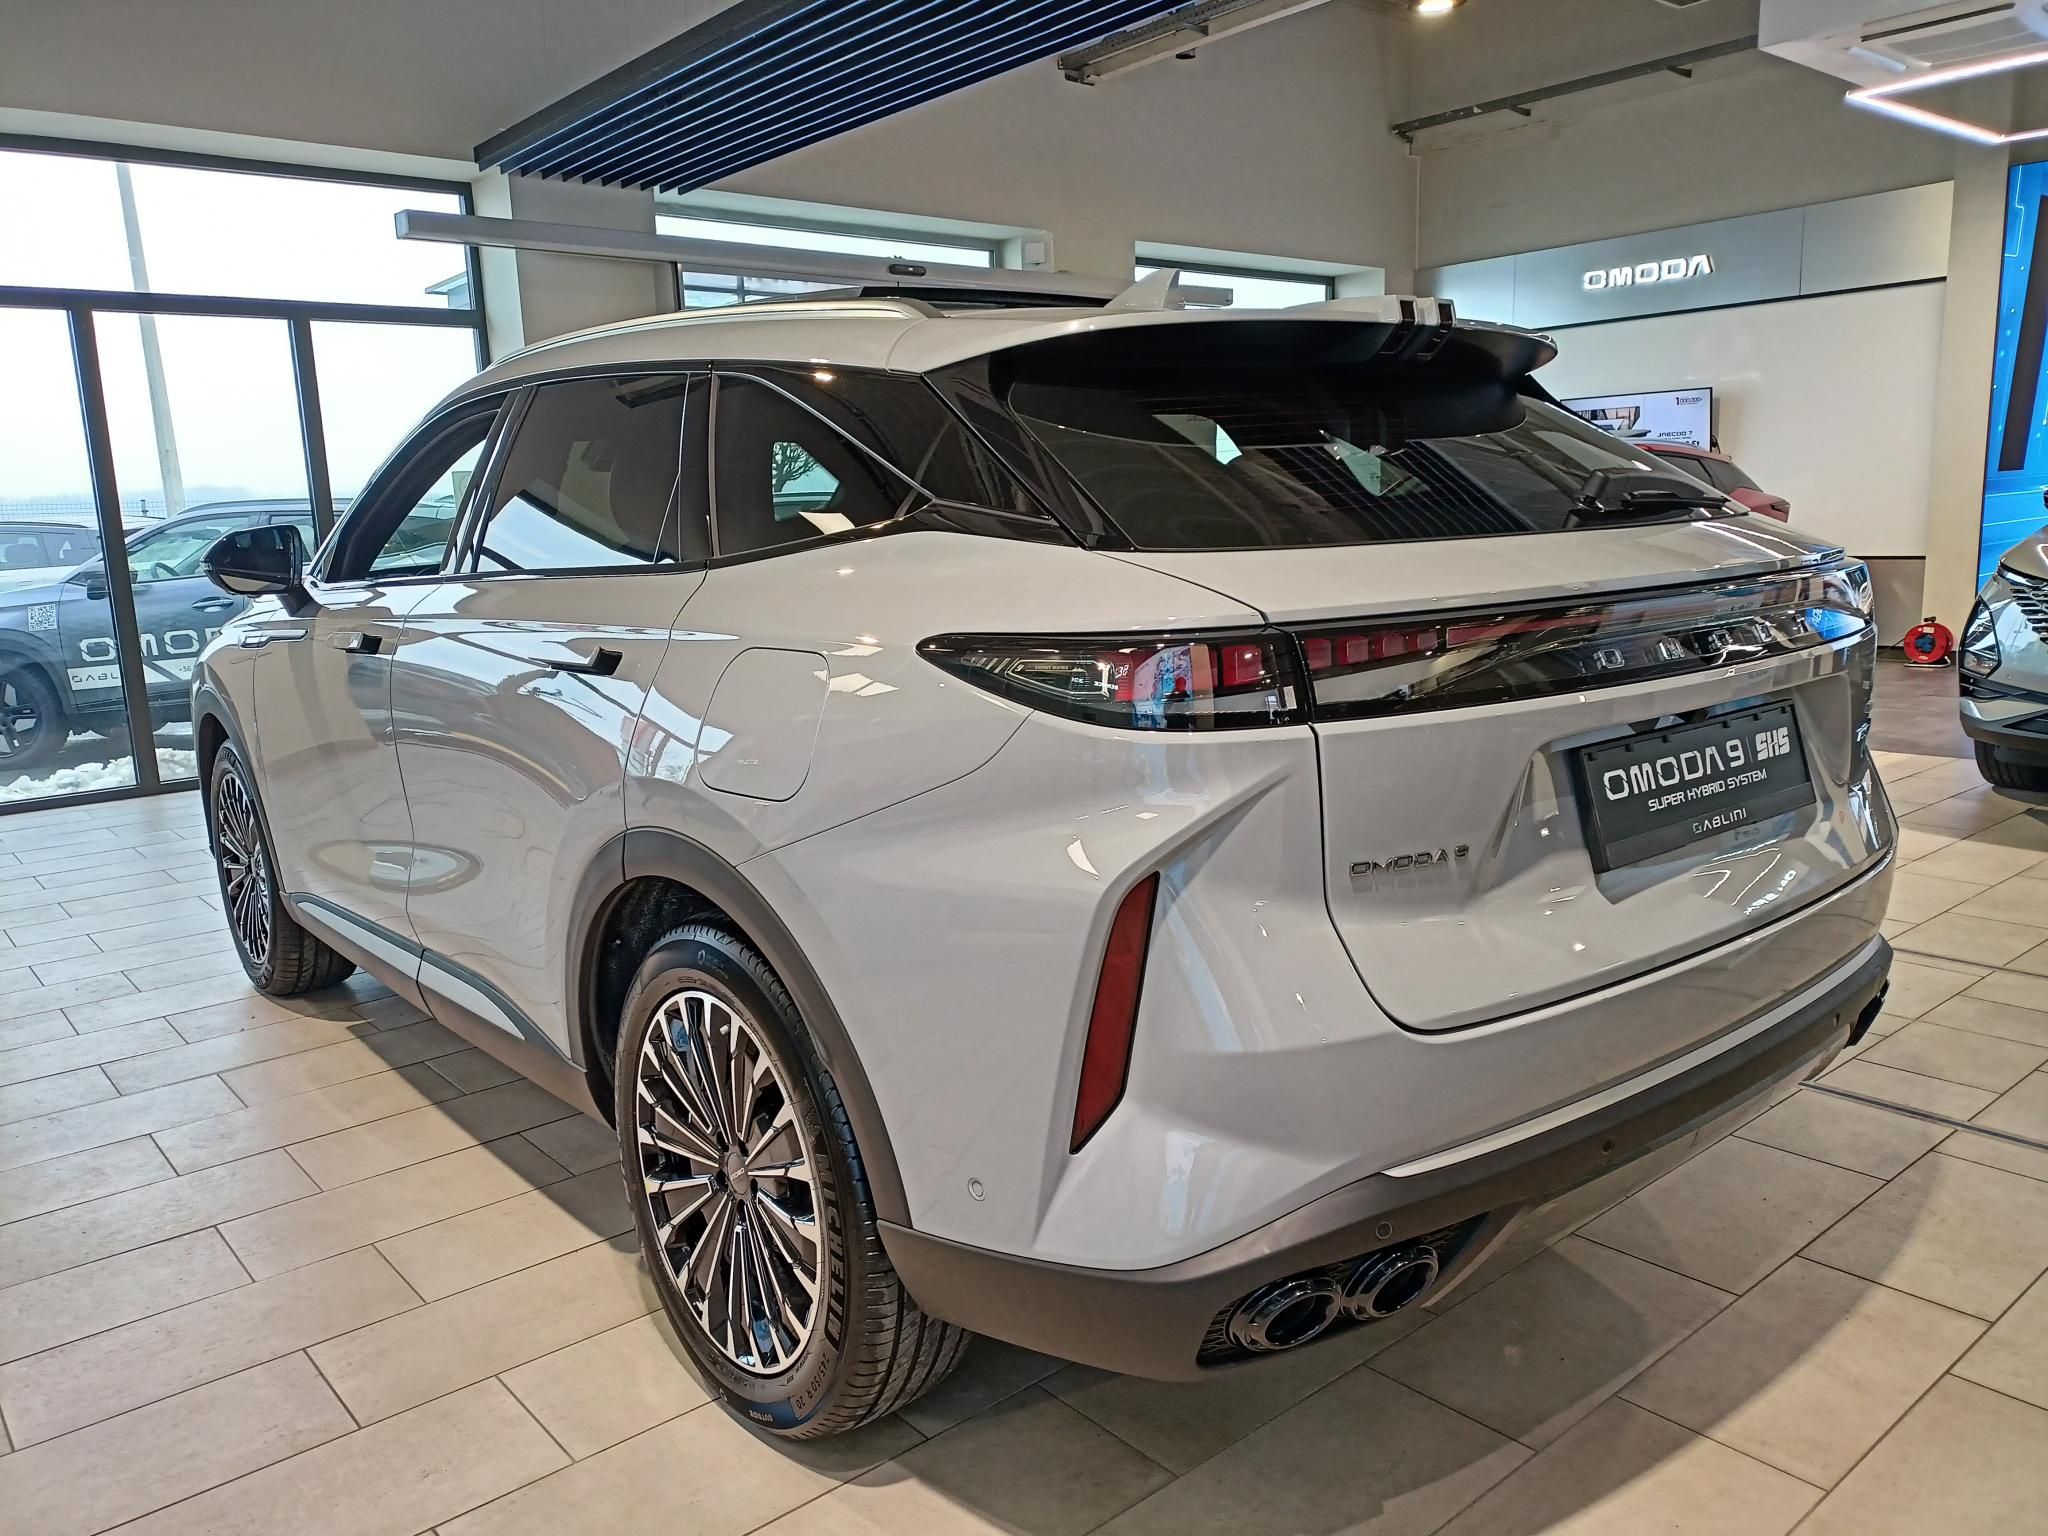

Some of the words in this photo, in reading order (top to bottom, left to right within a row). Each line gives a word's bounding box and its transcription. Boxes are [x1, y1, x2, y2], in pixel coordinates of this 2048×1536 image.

[1583, 253, 1714, 290] OMODA
[1602, 746, 1725, 802] OMODA
[1727, 738, 1745, 768] 9
[1755, 726, 1791, 761] SHS
[1648, 791, 1686, 812] SUPER
[1687, 780, 1726, 802] HYBRID
[1727, 768, 1767, 791] SYSTEM
[1692, 807, 1748, 835] GABLINI
[1349, 848, 1450, 877] OMODA
[1454, 843, 1470, 858] 9
[816, 1154, 844, 1343] MICHELIN
[809, 1352, 831, 1393] 245/50
